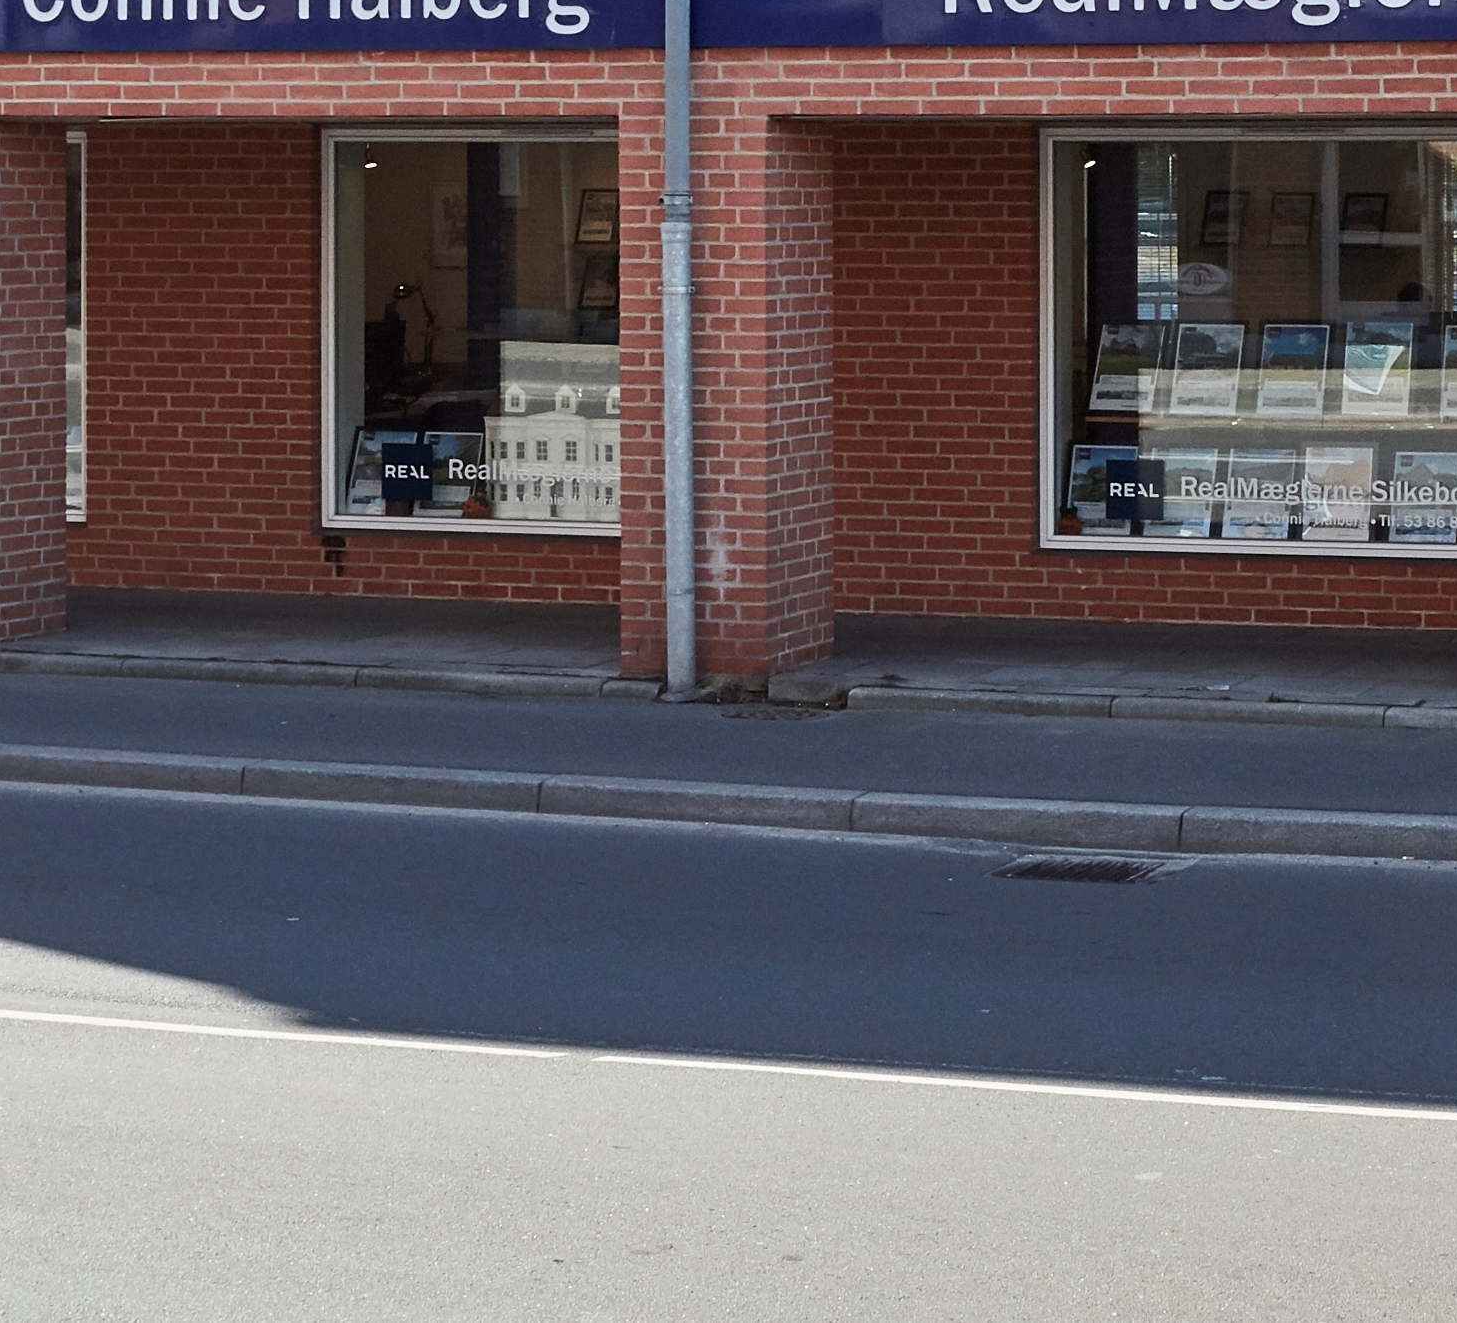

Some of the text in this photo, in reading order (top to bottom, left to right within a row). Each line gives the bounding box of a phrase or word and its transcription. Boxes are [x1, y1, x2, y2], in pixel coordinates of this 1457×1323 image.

[385, 464, 430, 480] REAL
[1109, 482, 1160, 498] REAL
[1180, 476, 1364, 506] RealMæglerne
[1404, 516, 1423, 528] 53
[1426, 516, 1446, 529] 86
